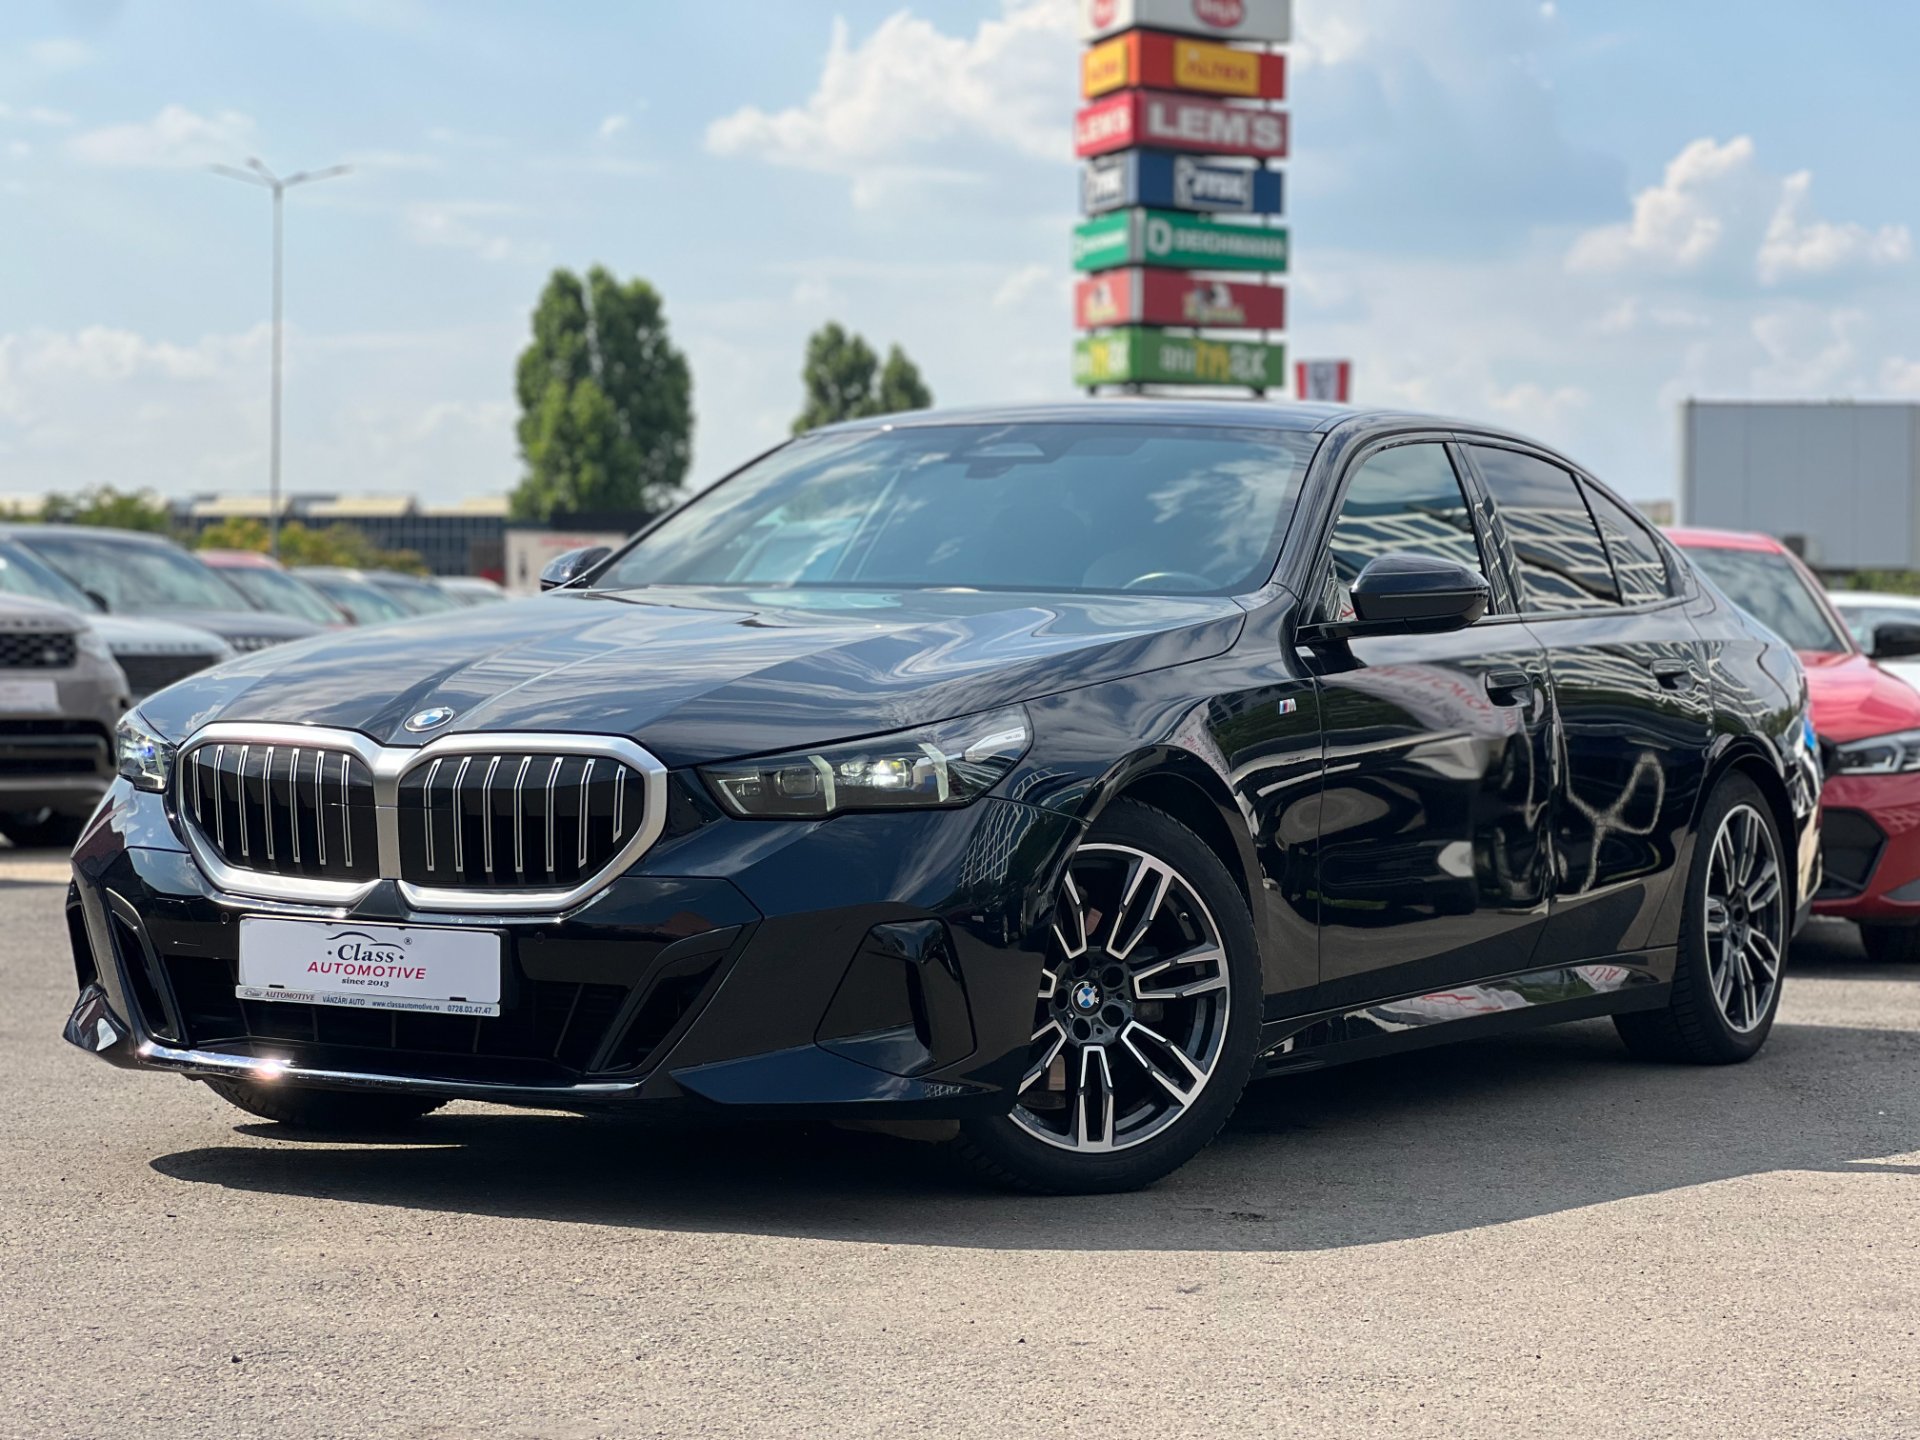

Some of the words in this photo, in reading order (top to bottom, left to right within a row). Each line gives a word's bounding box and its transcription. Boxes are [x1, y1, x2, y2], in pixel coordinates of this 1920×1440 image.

[338, 943, 395, 963] Class
[307, 961, 427, 980] AUTOMOTIVE
[342, 977, 366, 986] since
[367, 979, 390, 988] 2013
[265, 991, 315, 1002] AUTOMOTIVE
[348, 997, 366, 1007] AUTO
[371, 1000, 440, 1012] www.classautomotive.ro
[447, 1004, 492, 1015] 0728.03.47.47
